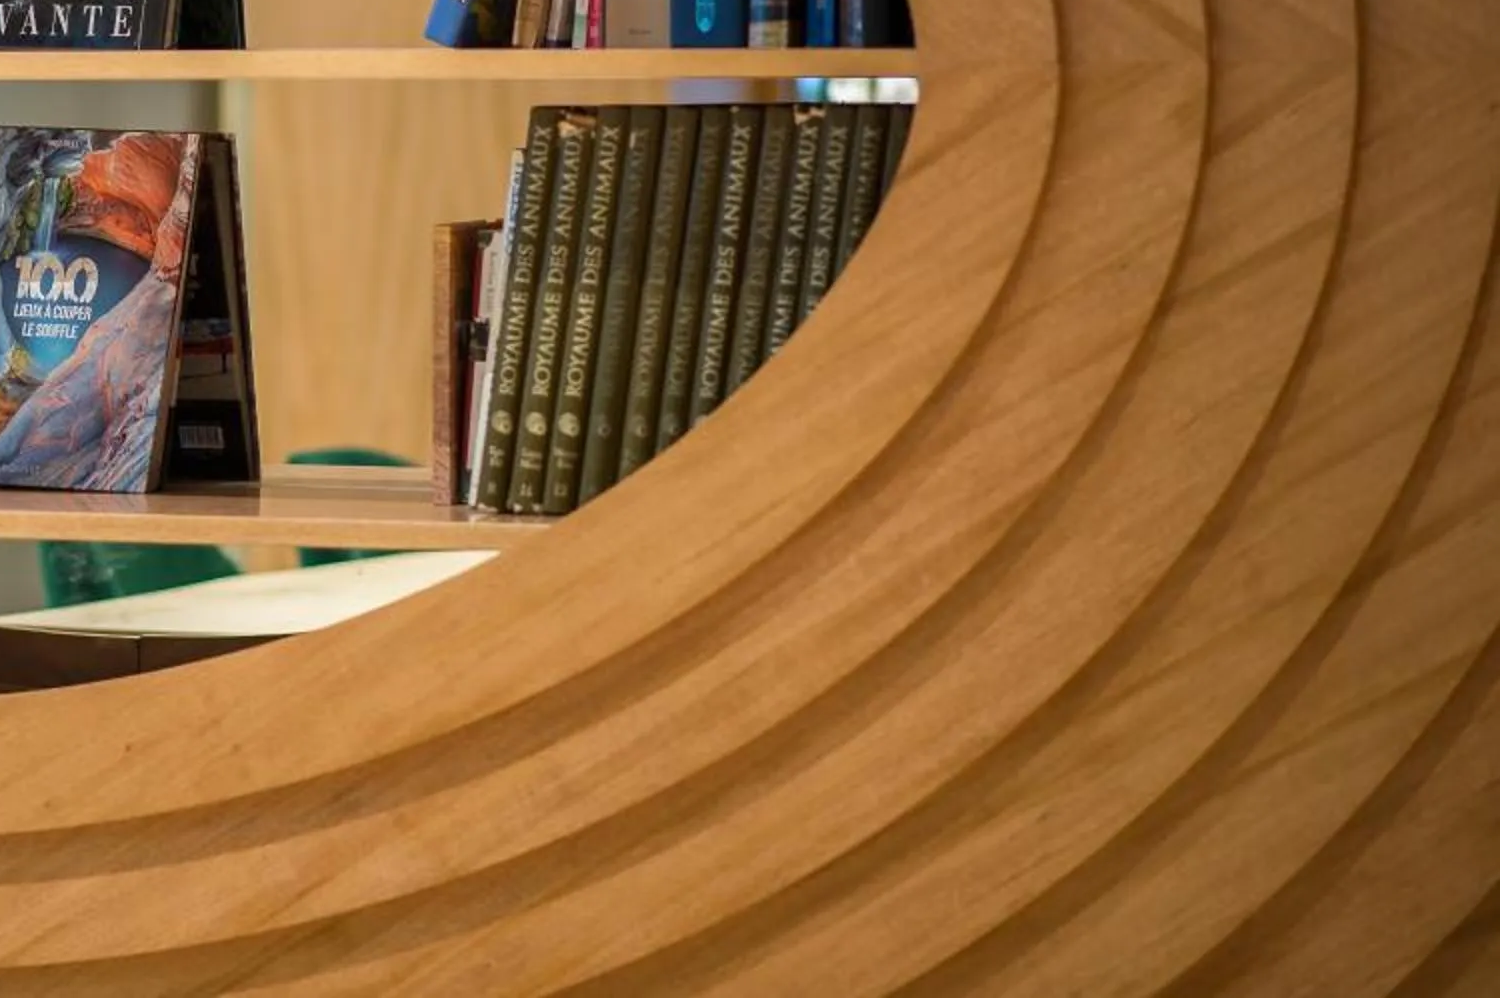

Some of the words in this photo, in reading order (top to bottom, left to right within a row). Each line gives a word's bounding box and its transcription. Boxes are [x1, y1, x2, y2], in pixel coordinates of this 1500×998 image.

[521, 126, 552, 238] ANIMAUX
[555, 128, 585, 238] ANIMAUX
[589, 125, 620, 239] ANIMAUX
[721, 123, 750, 240] ANIMAUX
[788, 124, 818, 238] ANIMAUX
[817, 125, 848, 239] ANIMAUX
[13, 302, 41, 318] LIEUX
[53, 304, 93, 320] COUPER
[14, 252, 99, 303] 100
[515, 244, 535, 284] DES
[548, 245, 568, 284] DES
[581, 245, 601, 285] DES
[714, 245, 735, 285] DES
[781, 246, 799, 285] DES
[810, 246, 830, 286] DES
[21, 321, 35, 337] LE
[35, 323, 79, 339] SOUFFLE
[499, 291, 529, 396] ROYAUME
[531, 292, 563, 397] ROYAUME
[564, 293, 596, 398] ROYAUME
[699, 294, 730, 398] ROYAUME
